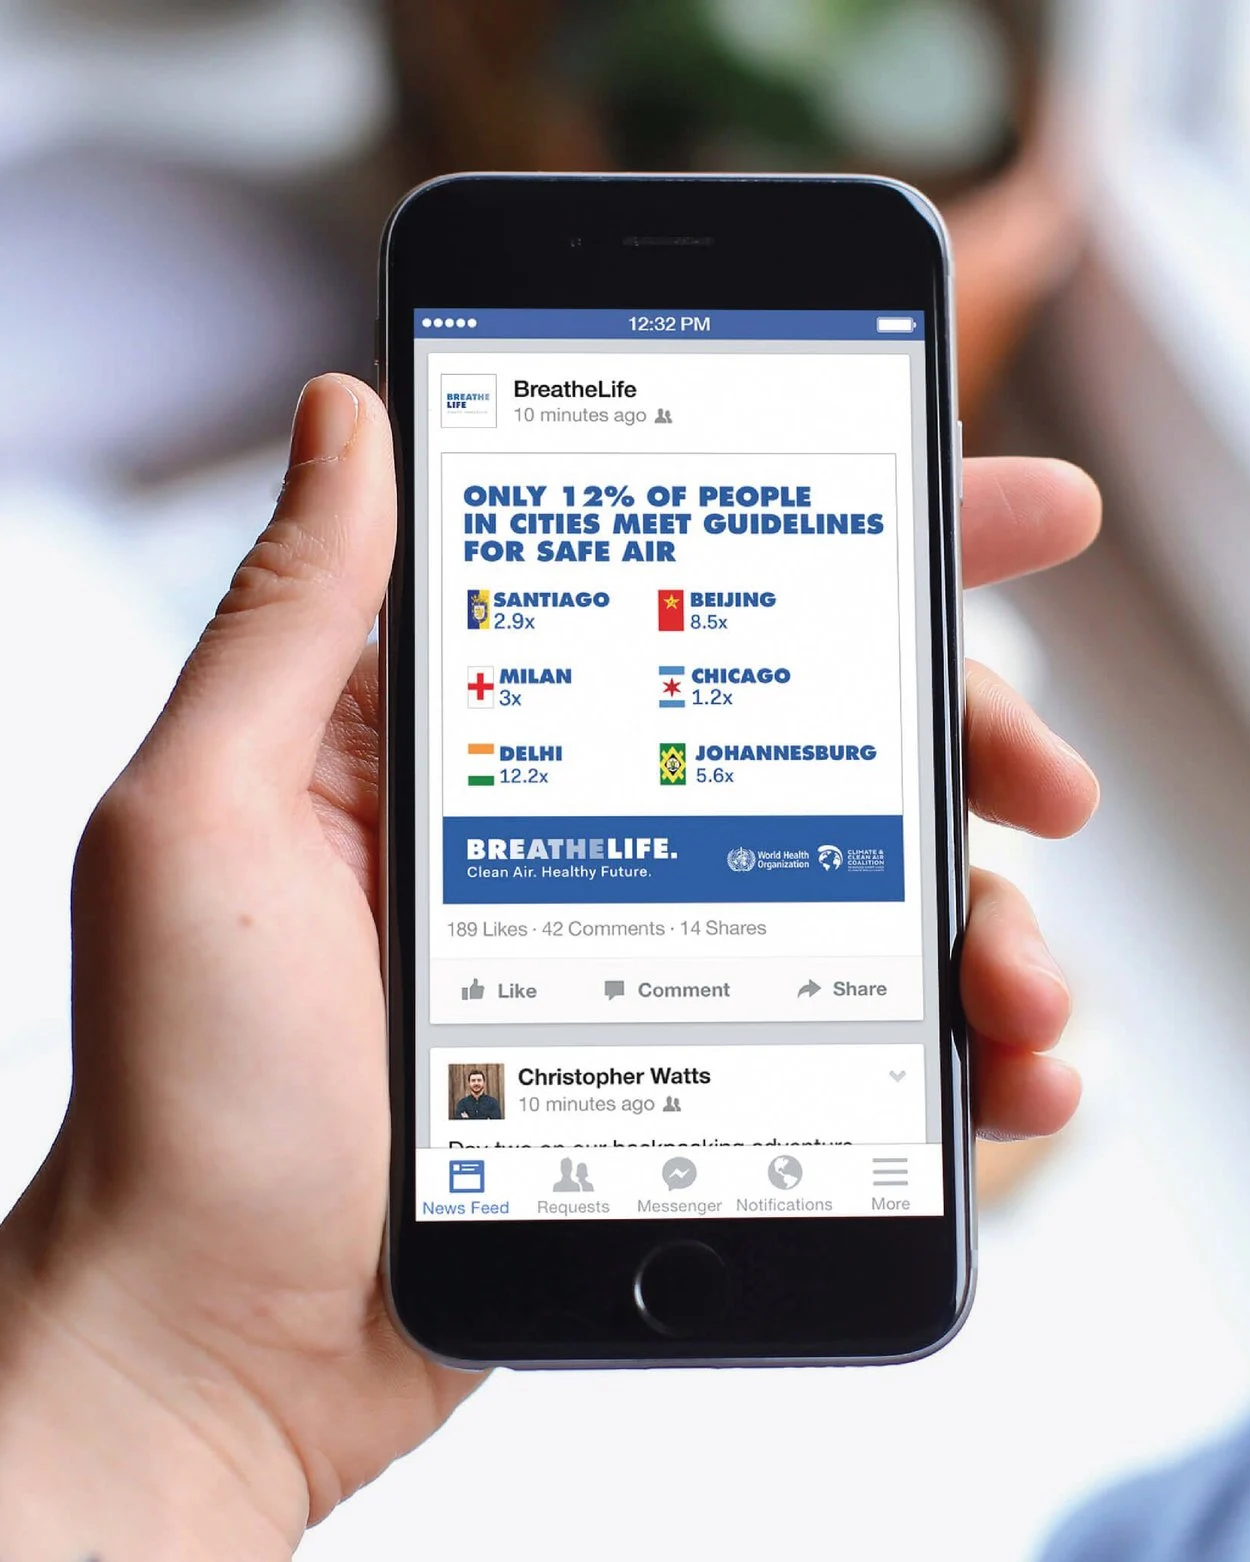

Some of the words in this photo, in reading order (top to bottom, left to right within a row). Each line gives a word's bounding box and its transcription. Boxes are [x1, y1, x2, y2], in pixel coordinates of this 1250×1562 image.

[629, 317, 676, 331] 12:32
[681, 317, 710, 331] PM
[515, 380, 637, 398] BreatheLife
[447, 393, 489, 402] BREATHE
[514, 408, 534, 422] 10
[541, 408, 608, 422] minutes
[614, 411, 646, 426] ago
[464, 485, 547, 507] ONLY
[563, 485, 635, 507] 12%
[647, 486, 686, 507] OF
[699, 486, 811, 507] PEOPLE
[465, 513, 496, 534] IN
[510, 513, 600, 534] CITIES
[613, 513, 691, 534] MEET
[704, 513, 884, 535] GUIDELINES
[464, 540, 525, 562] FOR
[537, 540, 610, 562] SAFE
[622, 541, 676, 562] AIR
[494, 592, 610, 607] SANTIAGO
[691, 592, 776, 607] BEIJING
[494, 613, 535, 629] 2.9x
[691, 614, 727, 629] 8.5x
[500, 668, 571, 684] MILAN
[692, 668, 791, 684] CHICAGO
[500, 689, 521, 706] 3x
[693, 689, 732, 705] 1.2x
[500, 746, 562, 761] DELHI
[695, 745, 877, 761] JOHANNESBURG
[500, 768, 548, 783] 12.2x
[697, 768, 733, 783] 5.6x
[467, 838, 677, 860] BREATHELIFE.
[758, 851, 781, 859] World
[783, 851, 809, 859] Health
[758, 859, 809, 870] Organization
[467, 866, 509, 877] Clean
[513, 866, 536, 877] Air.
[542, 865, 596, 880] Healthy
[601, 866, 651, 877] Future.
[448, 922, 477, 937] 189
[484, 921, 528, 936] Likes
[542, 921, 563, 936] 42
[569, 921, 665, 936] Comments
[681, 921, 701, 935] 14
[706, 920, 766, 935] Shares
[498, 983, 537, 998] Like
[638, 983, 730, 997] Comment
[833, 981, 887, 996] Share
[519, 1068, 645, 1089] Christopher
[650, 1067, 711, 1084] Watts
[520, 1097, 539, 1112] 10
[547, 1097, 616, 1111] minutes
[622, 1099, 655, 1115] ago
[423, 1202, 465, 1215] News
[471, 1201, 509, 1214] Feed
[537, 1201, 610, 1215] Requests
[637, 1199, 722, 1214] Messenger
[737, 1198, 832, 1212] Notifications
[872, 1197, 910, 1210] More
